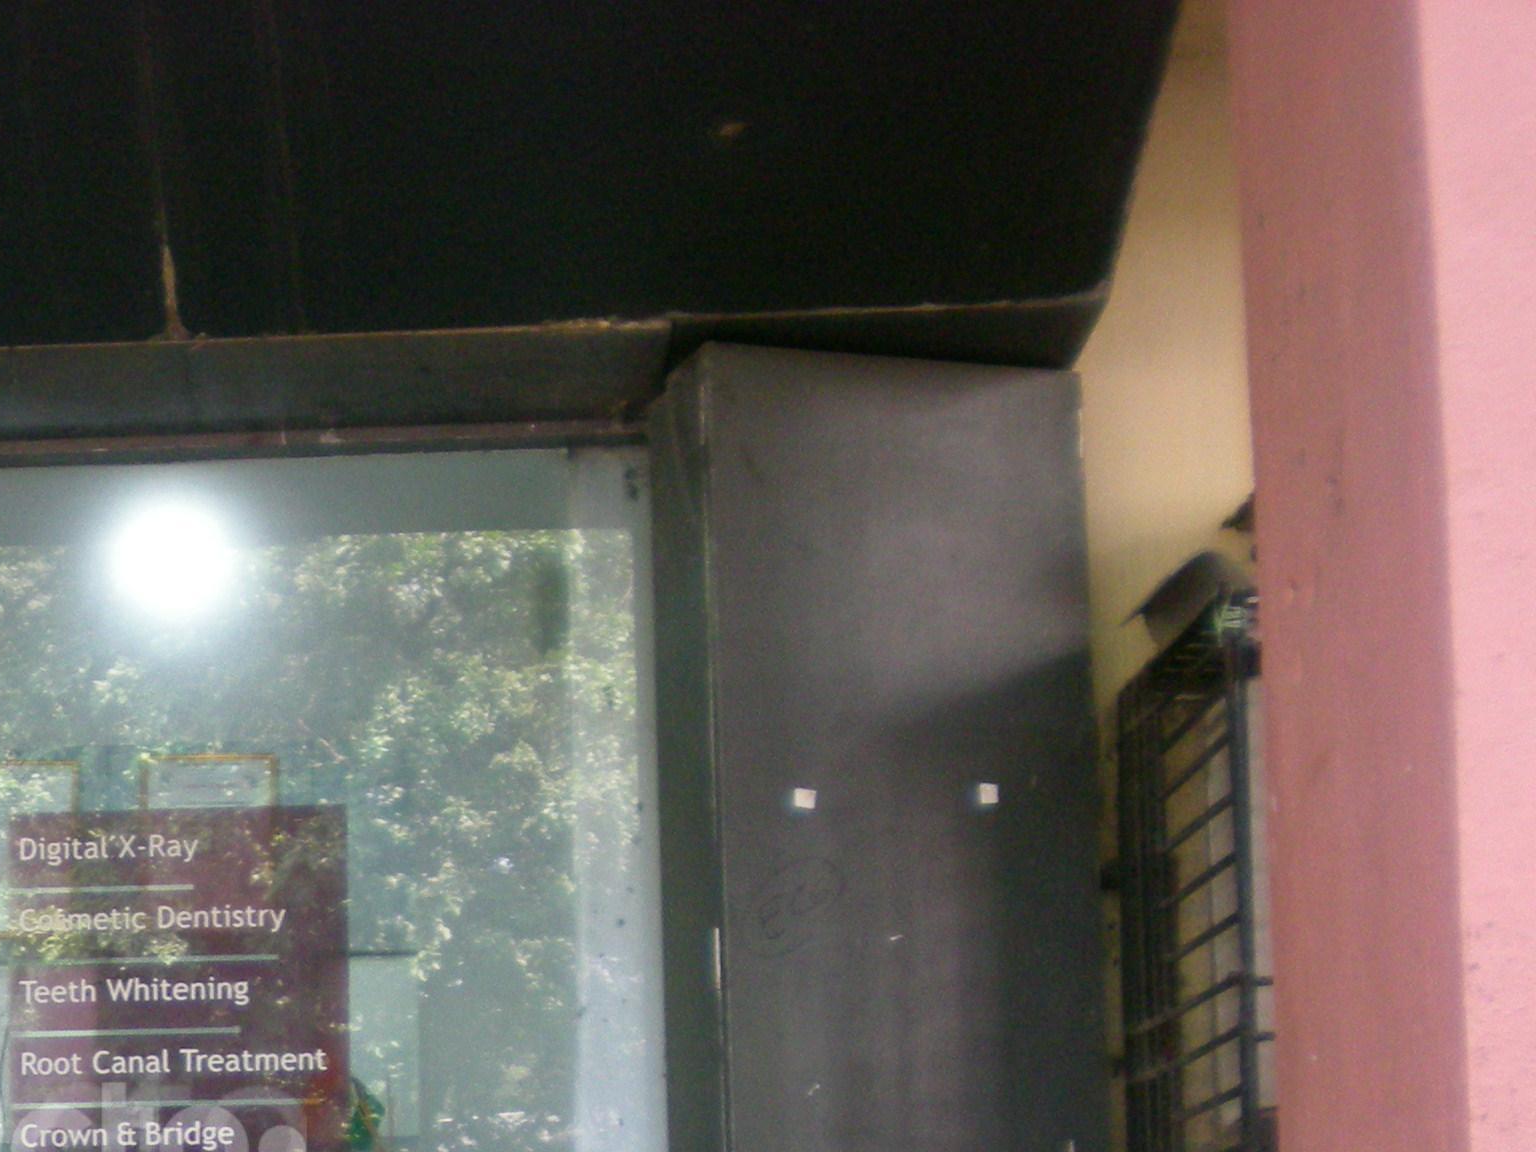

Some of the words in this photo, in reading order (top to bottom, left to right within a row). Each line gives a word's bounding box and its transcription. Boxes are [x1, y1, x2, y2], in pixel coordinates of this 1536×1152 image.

[19, 834, 108, 865] Digital
[119, 834, 199, 862] X-Ray
[20, 907, 146, 933] Cosmetic
[157, 904, 287, 932] Dentistry
[19, 979, 97, 1005] Teeth
[107, 977, 250, 1006] Whitening
[21, 1051, 83, 1076] Root
[92, 1049, 170, 1075] Canal
[180, 1048, 328, 1073] Treatment
[21, 1124, 108, 1148] Crown
[117, 1122, 137, 1146] &
[145, 1121, 235, 1151] Bridge
